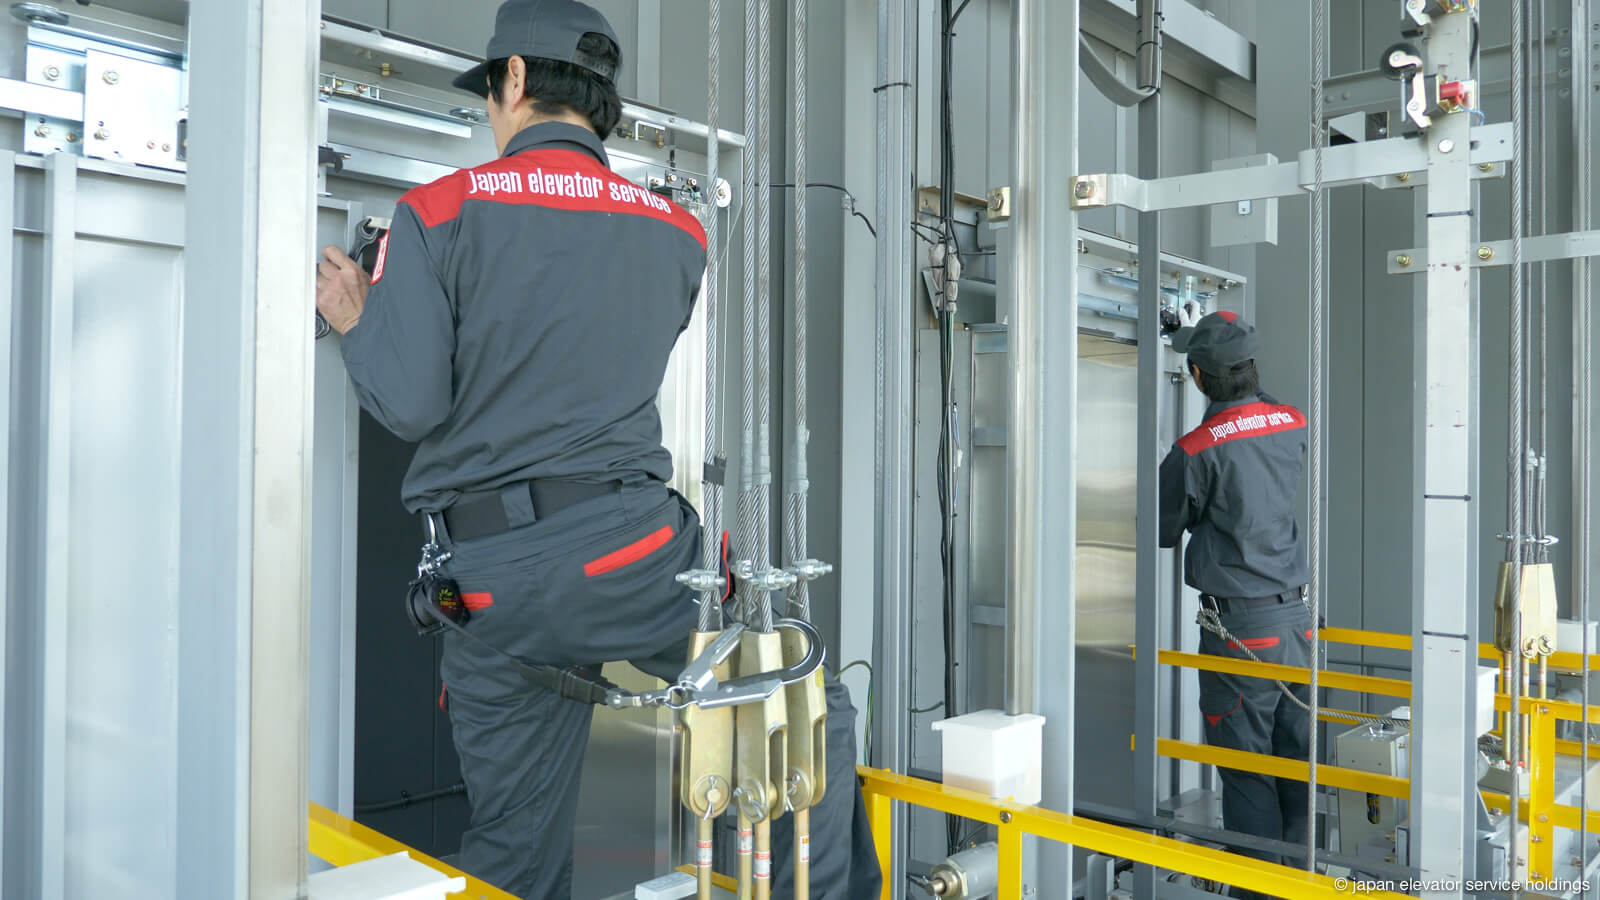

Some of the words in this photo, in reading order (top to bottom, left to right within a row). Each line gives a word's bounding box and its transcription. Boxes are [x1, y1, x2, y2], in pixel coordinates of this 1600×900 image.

[468, 170, 523, 195] japan
[527, 167, 604, 198] elevator
[609, 181, 672, 214] service
